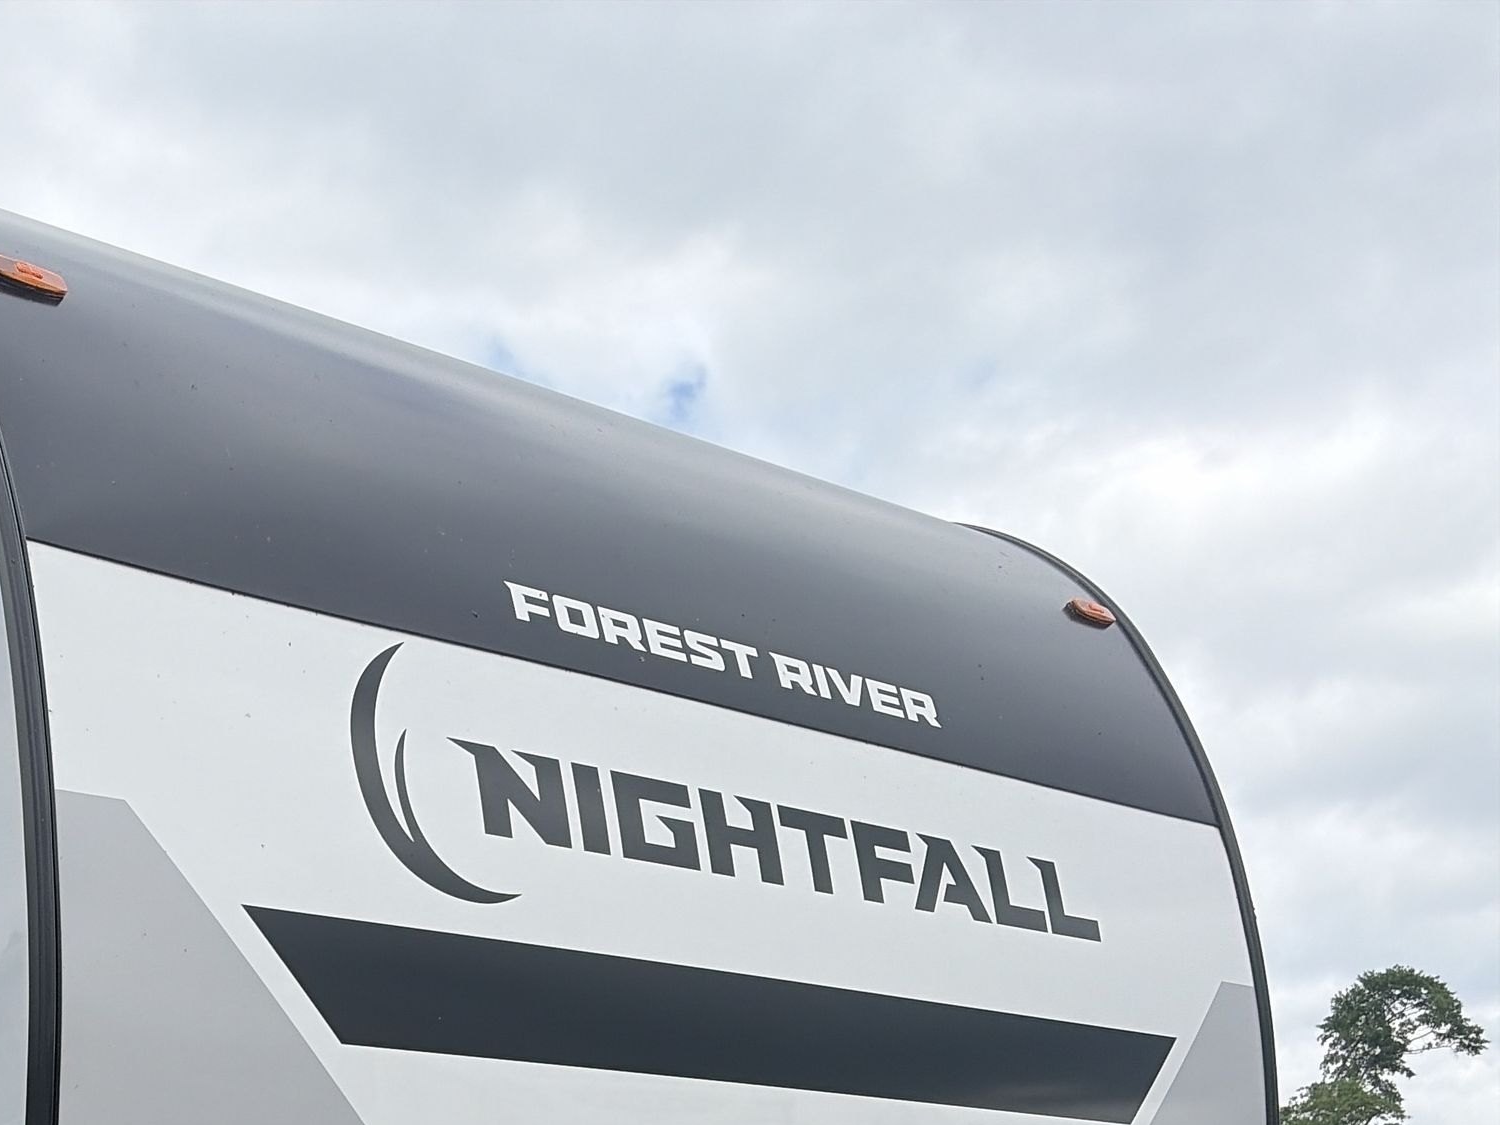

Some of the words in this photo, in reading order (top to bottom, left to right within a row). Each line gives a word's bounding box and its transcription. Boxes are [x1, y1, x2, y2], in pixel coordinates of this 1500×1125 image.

[503, 580, 758, 680] FOREST
[767, 650, 943, 729] RIVER
[445, 735, 1102, 943] NIGHTFALL
